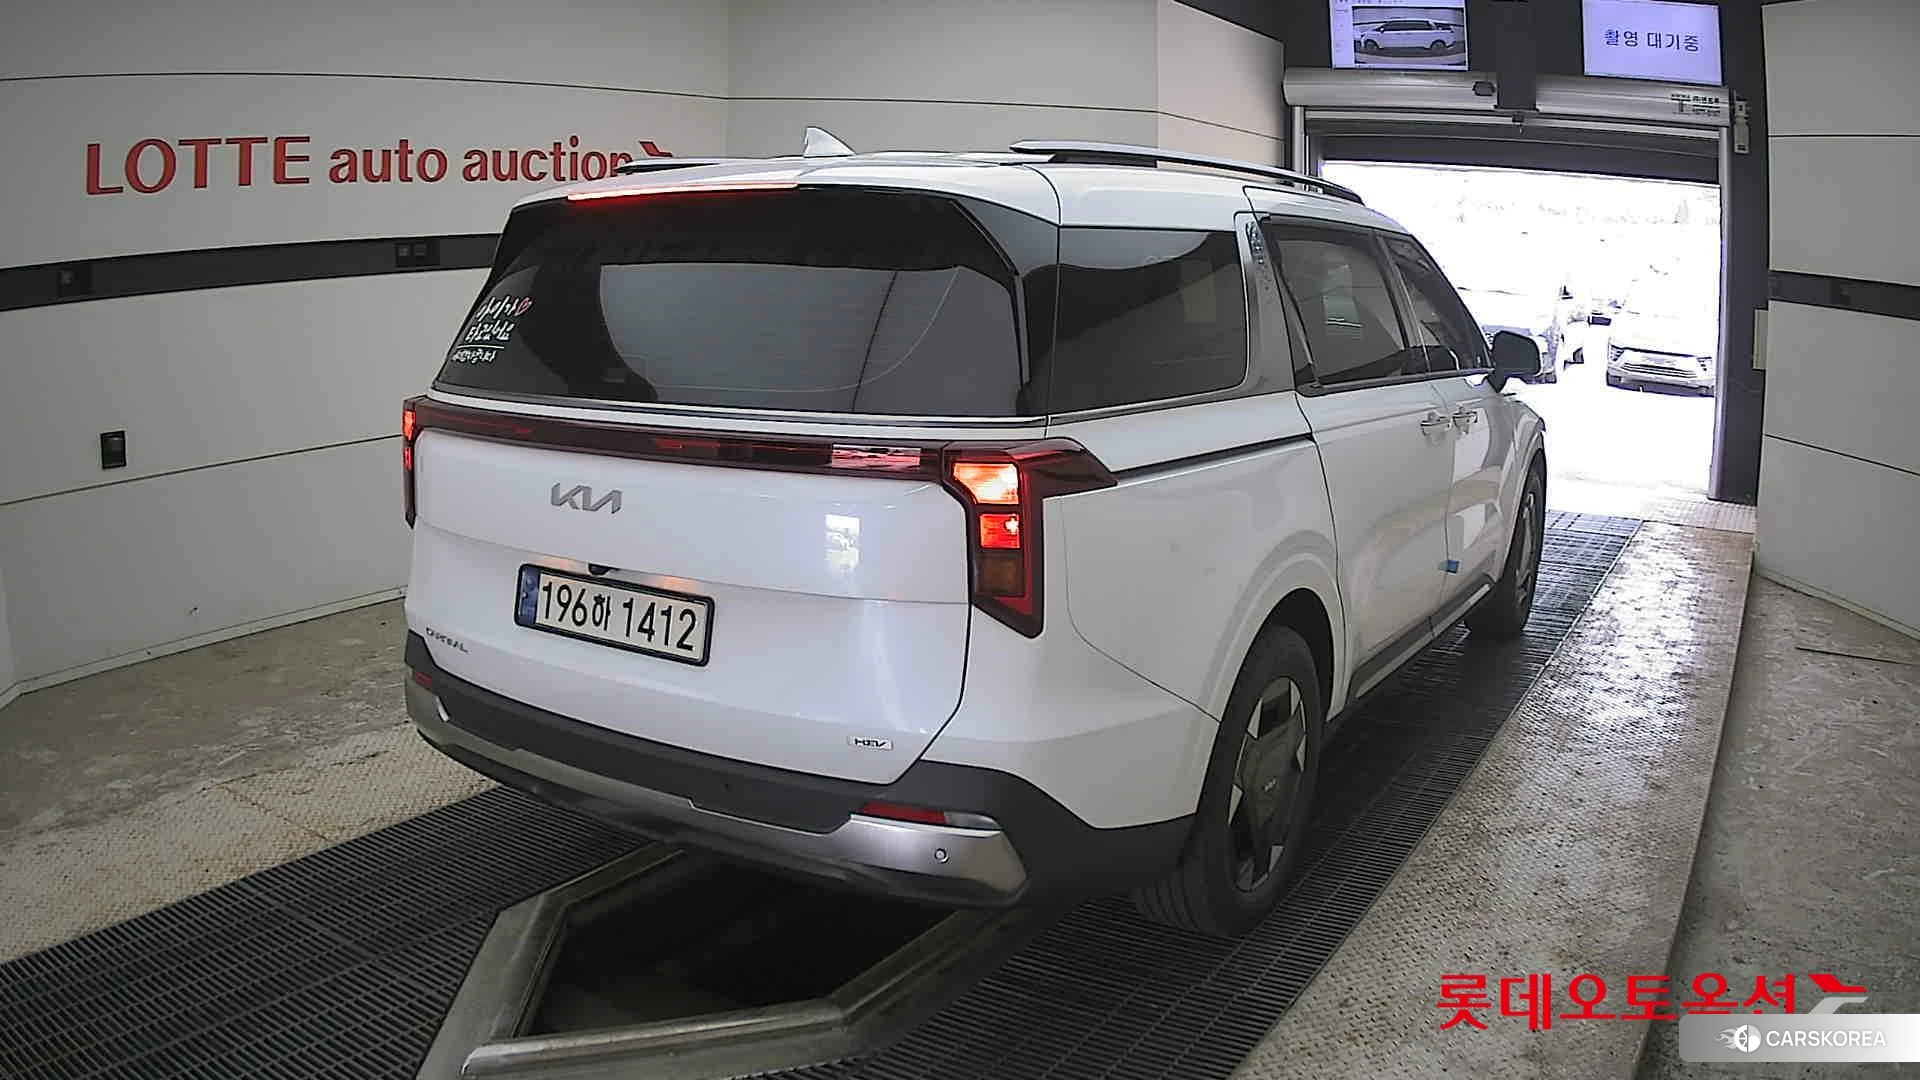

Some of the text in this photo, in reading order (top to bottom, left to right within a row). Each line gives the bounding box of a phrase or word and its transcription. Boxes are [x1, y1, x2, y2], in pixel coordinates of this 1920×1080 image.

[1604, 29, 1699, 52] 촬영 대기중
[87, 135, 634, 195] LOTTE auto auction
[551, 482, 622, 514] KIA
[542, 581, 697, 651] 196하 1412
